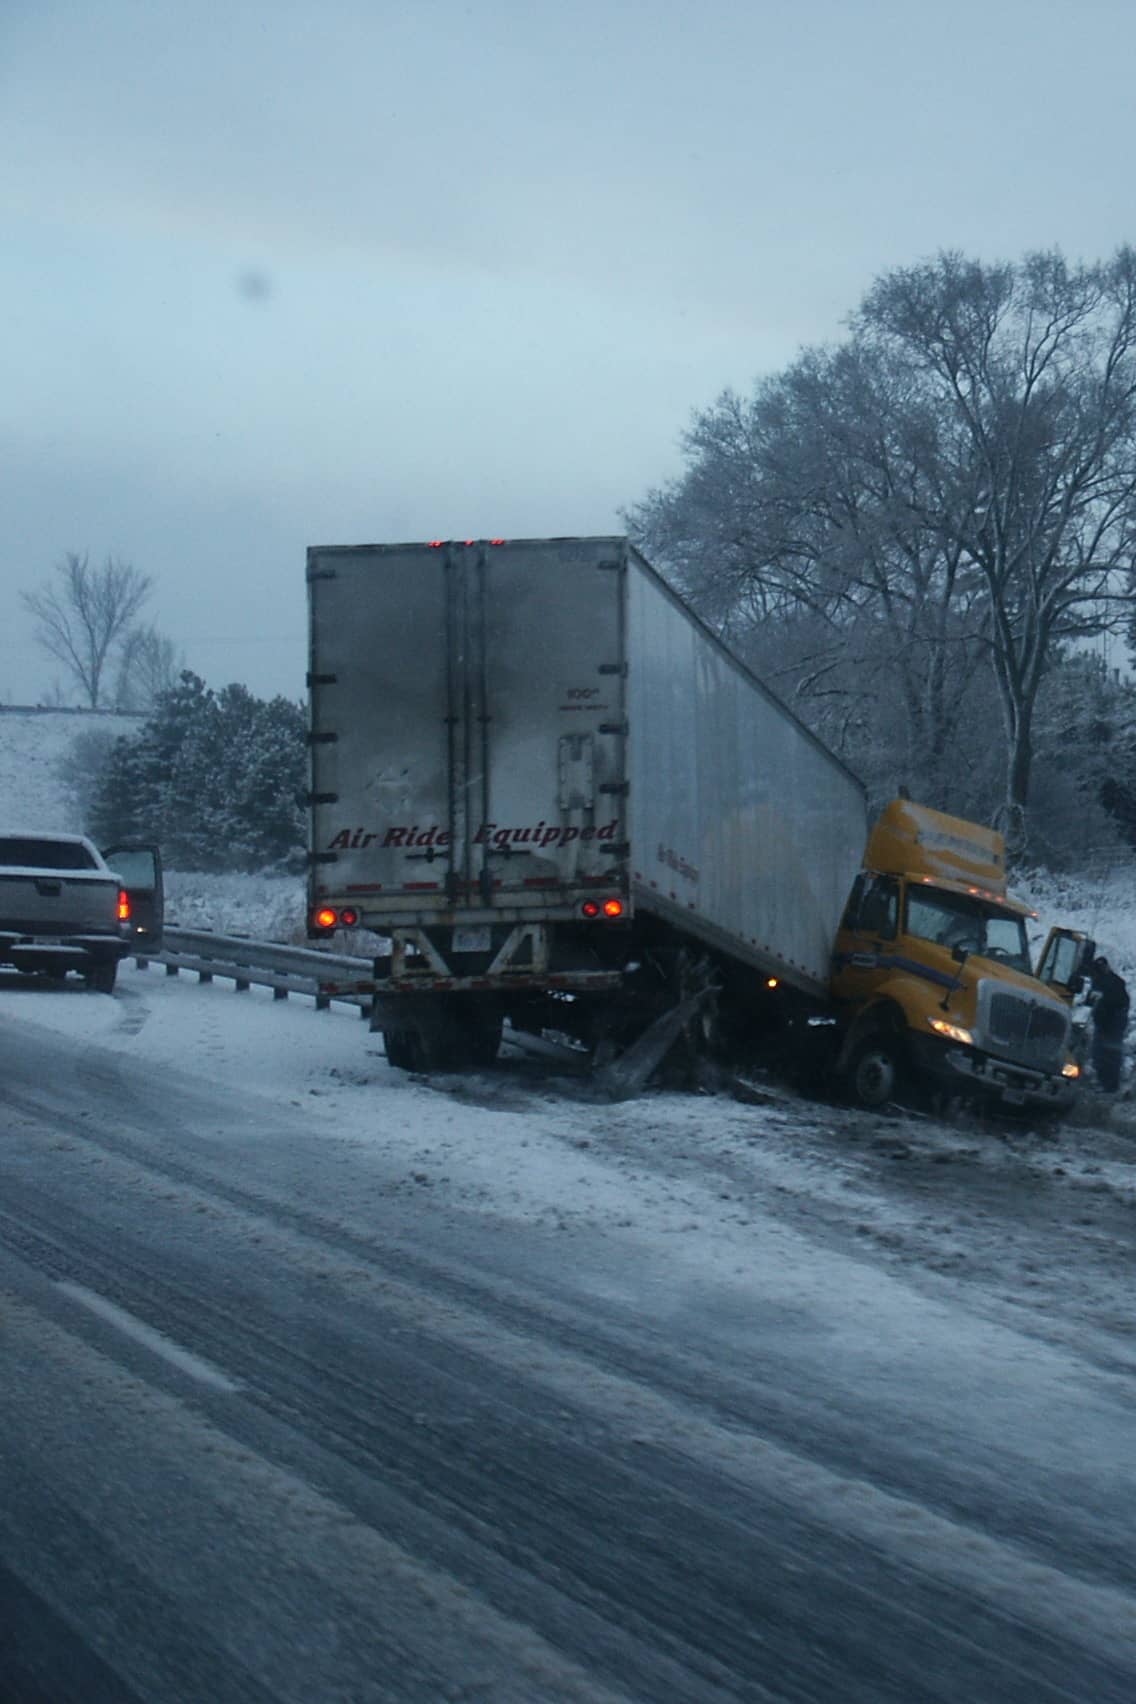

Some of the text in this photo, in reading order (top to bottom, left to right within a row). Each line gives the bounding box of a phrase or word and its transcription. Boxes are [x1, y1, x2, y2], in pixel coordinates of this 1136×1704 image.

[329, 820, 618, 848] Air Ride Equipped
